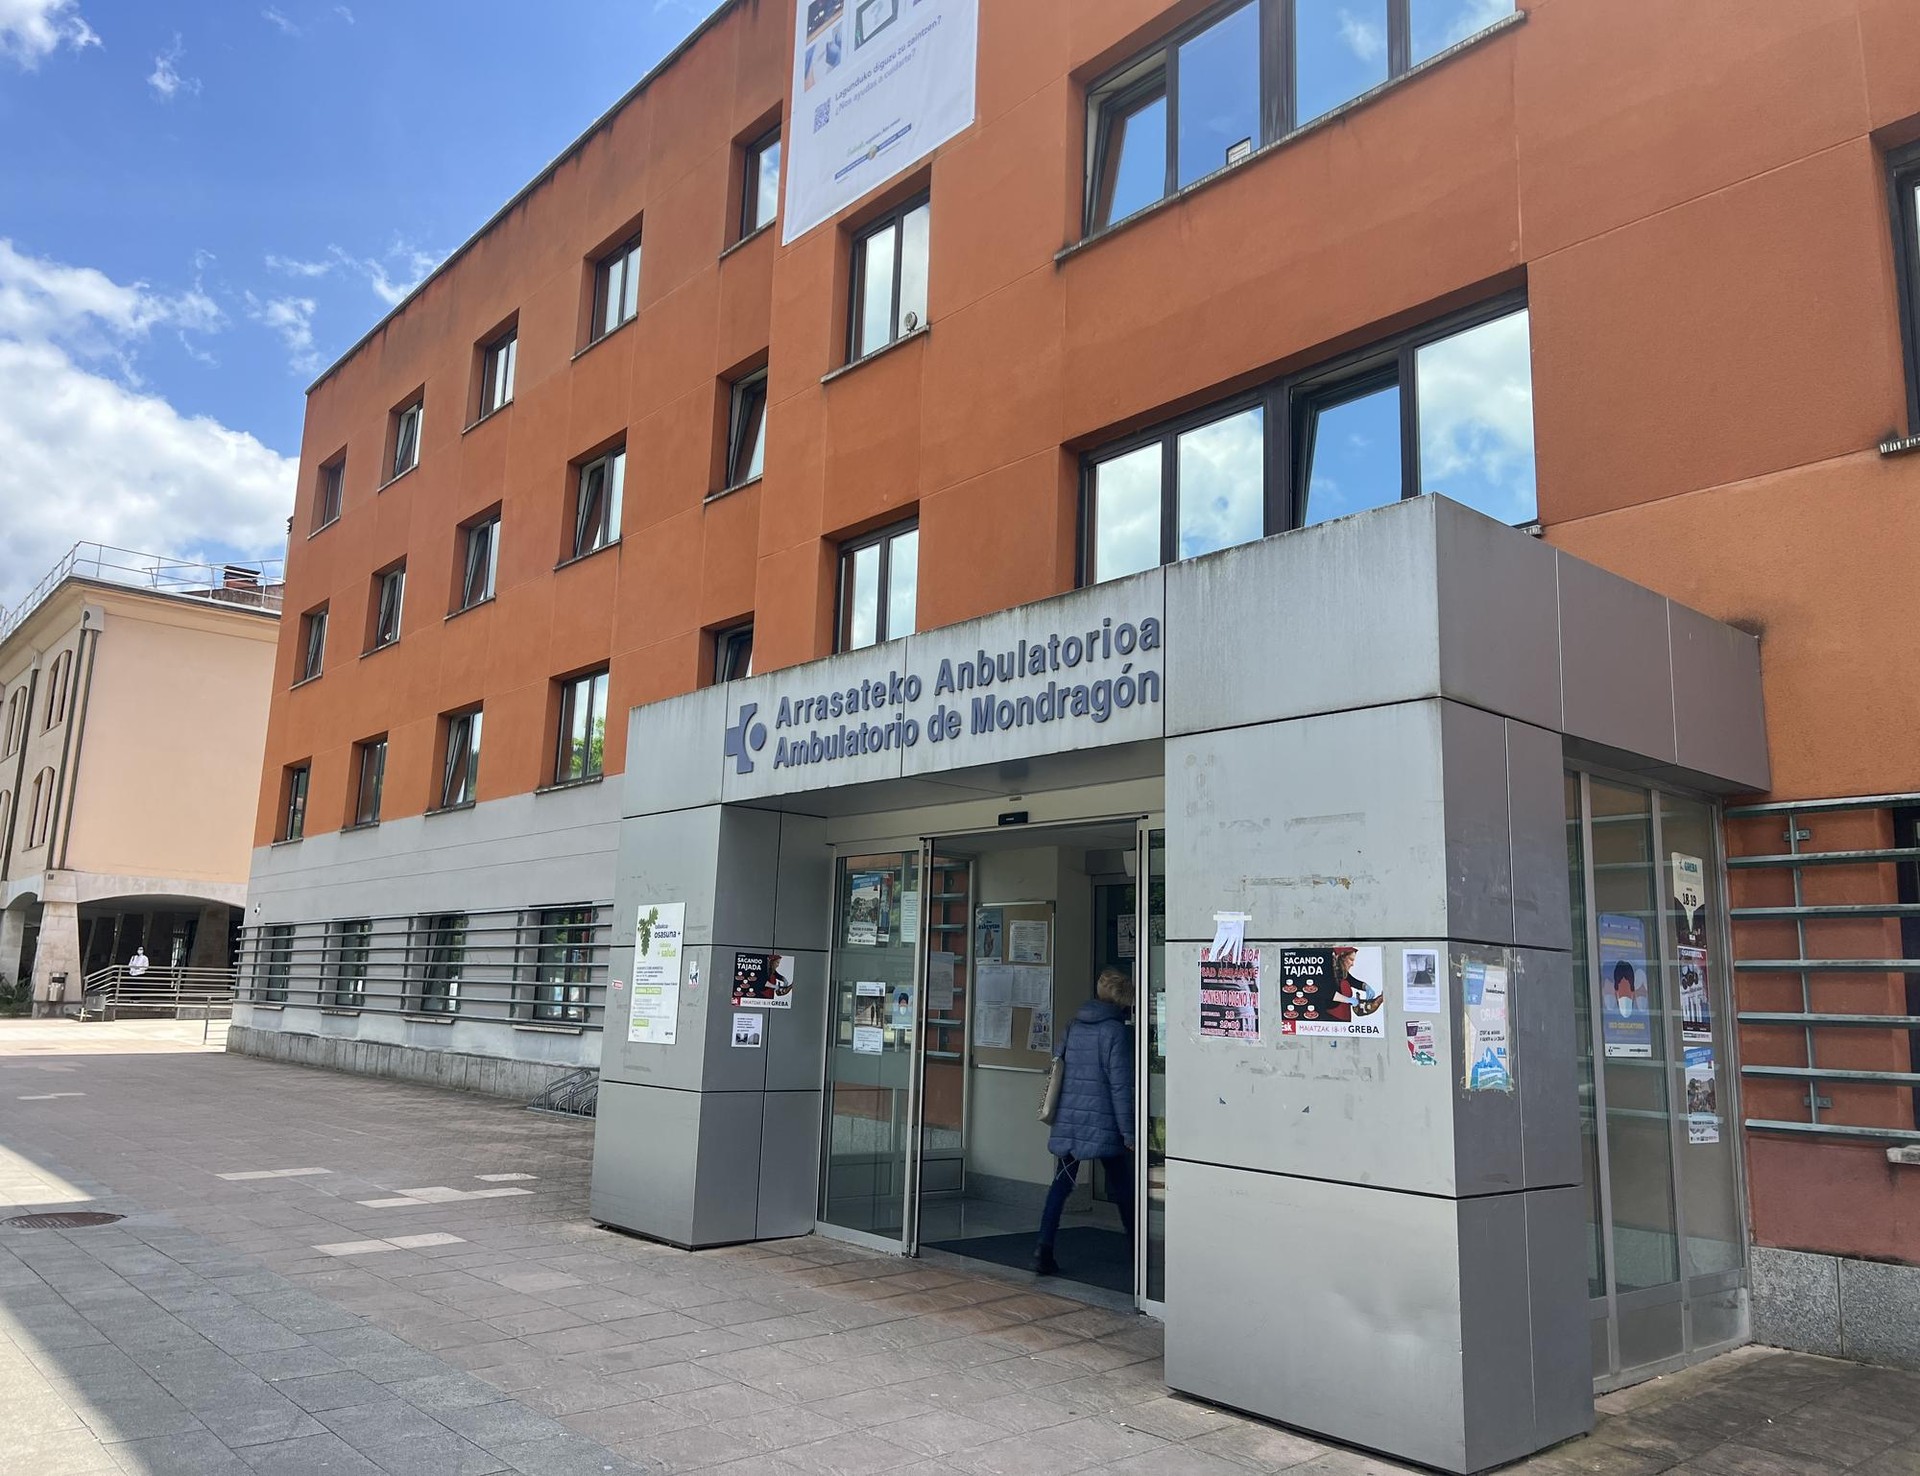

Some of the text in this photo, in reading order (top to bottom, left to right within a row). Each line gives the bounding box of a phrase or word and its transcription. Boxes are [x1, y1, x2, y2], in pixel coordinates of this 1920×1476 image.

[835, 70, 872, 100] Lagunduko
[775, 616, 1161, 729] Arrasateko Anbulatorioa
[773, 661, 1160, 769] Ambulatorio de Mondragón
[654, 930, 677, 938] osasuna
[737, 957, 763, 965] SACANDO
[1284, 957, 1324, 965] SACANDO
[737, 963, 762, 971] TAJADA
[1284, 966, 1324, 977] TAJADA
[1331, 1025, 1347, 1033] 18-19
[1348, 1025, 1380, 1034] GREBA
